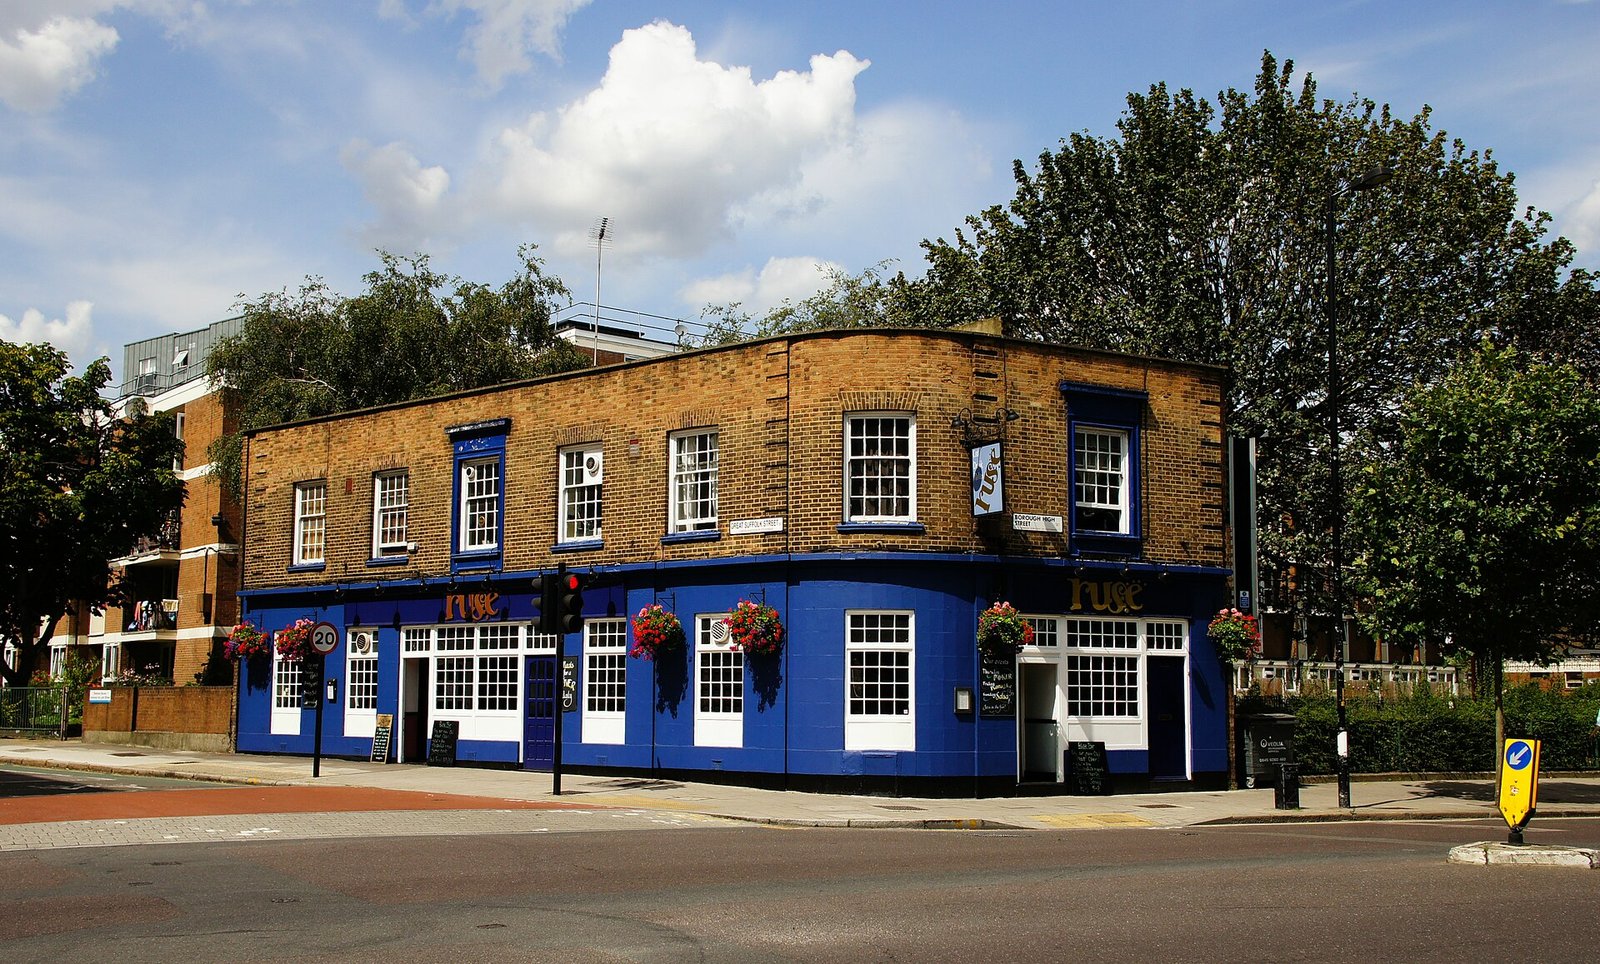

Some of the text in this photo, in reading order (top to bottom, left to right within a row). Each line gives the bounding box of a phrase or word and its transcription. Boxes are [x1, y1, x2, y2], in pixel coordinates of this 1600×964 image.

[731, 521, 744, 529] GREAT
[744, 520, 762, 529] SUFFOLK
[763, 519, 779, 528] STREET
[314, 631, 335, 645] 20
